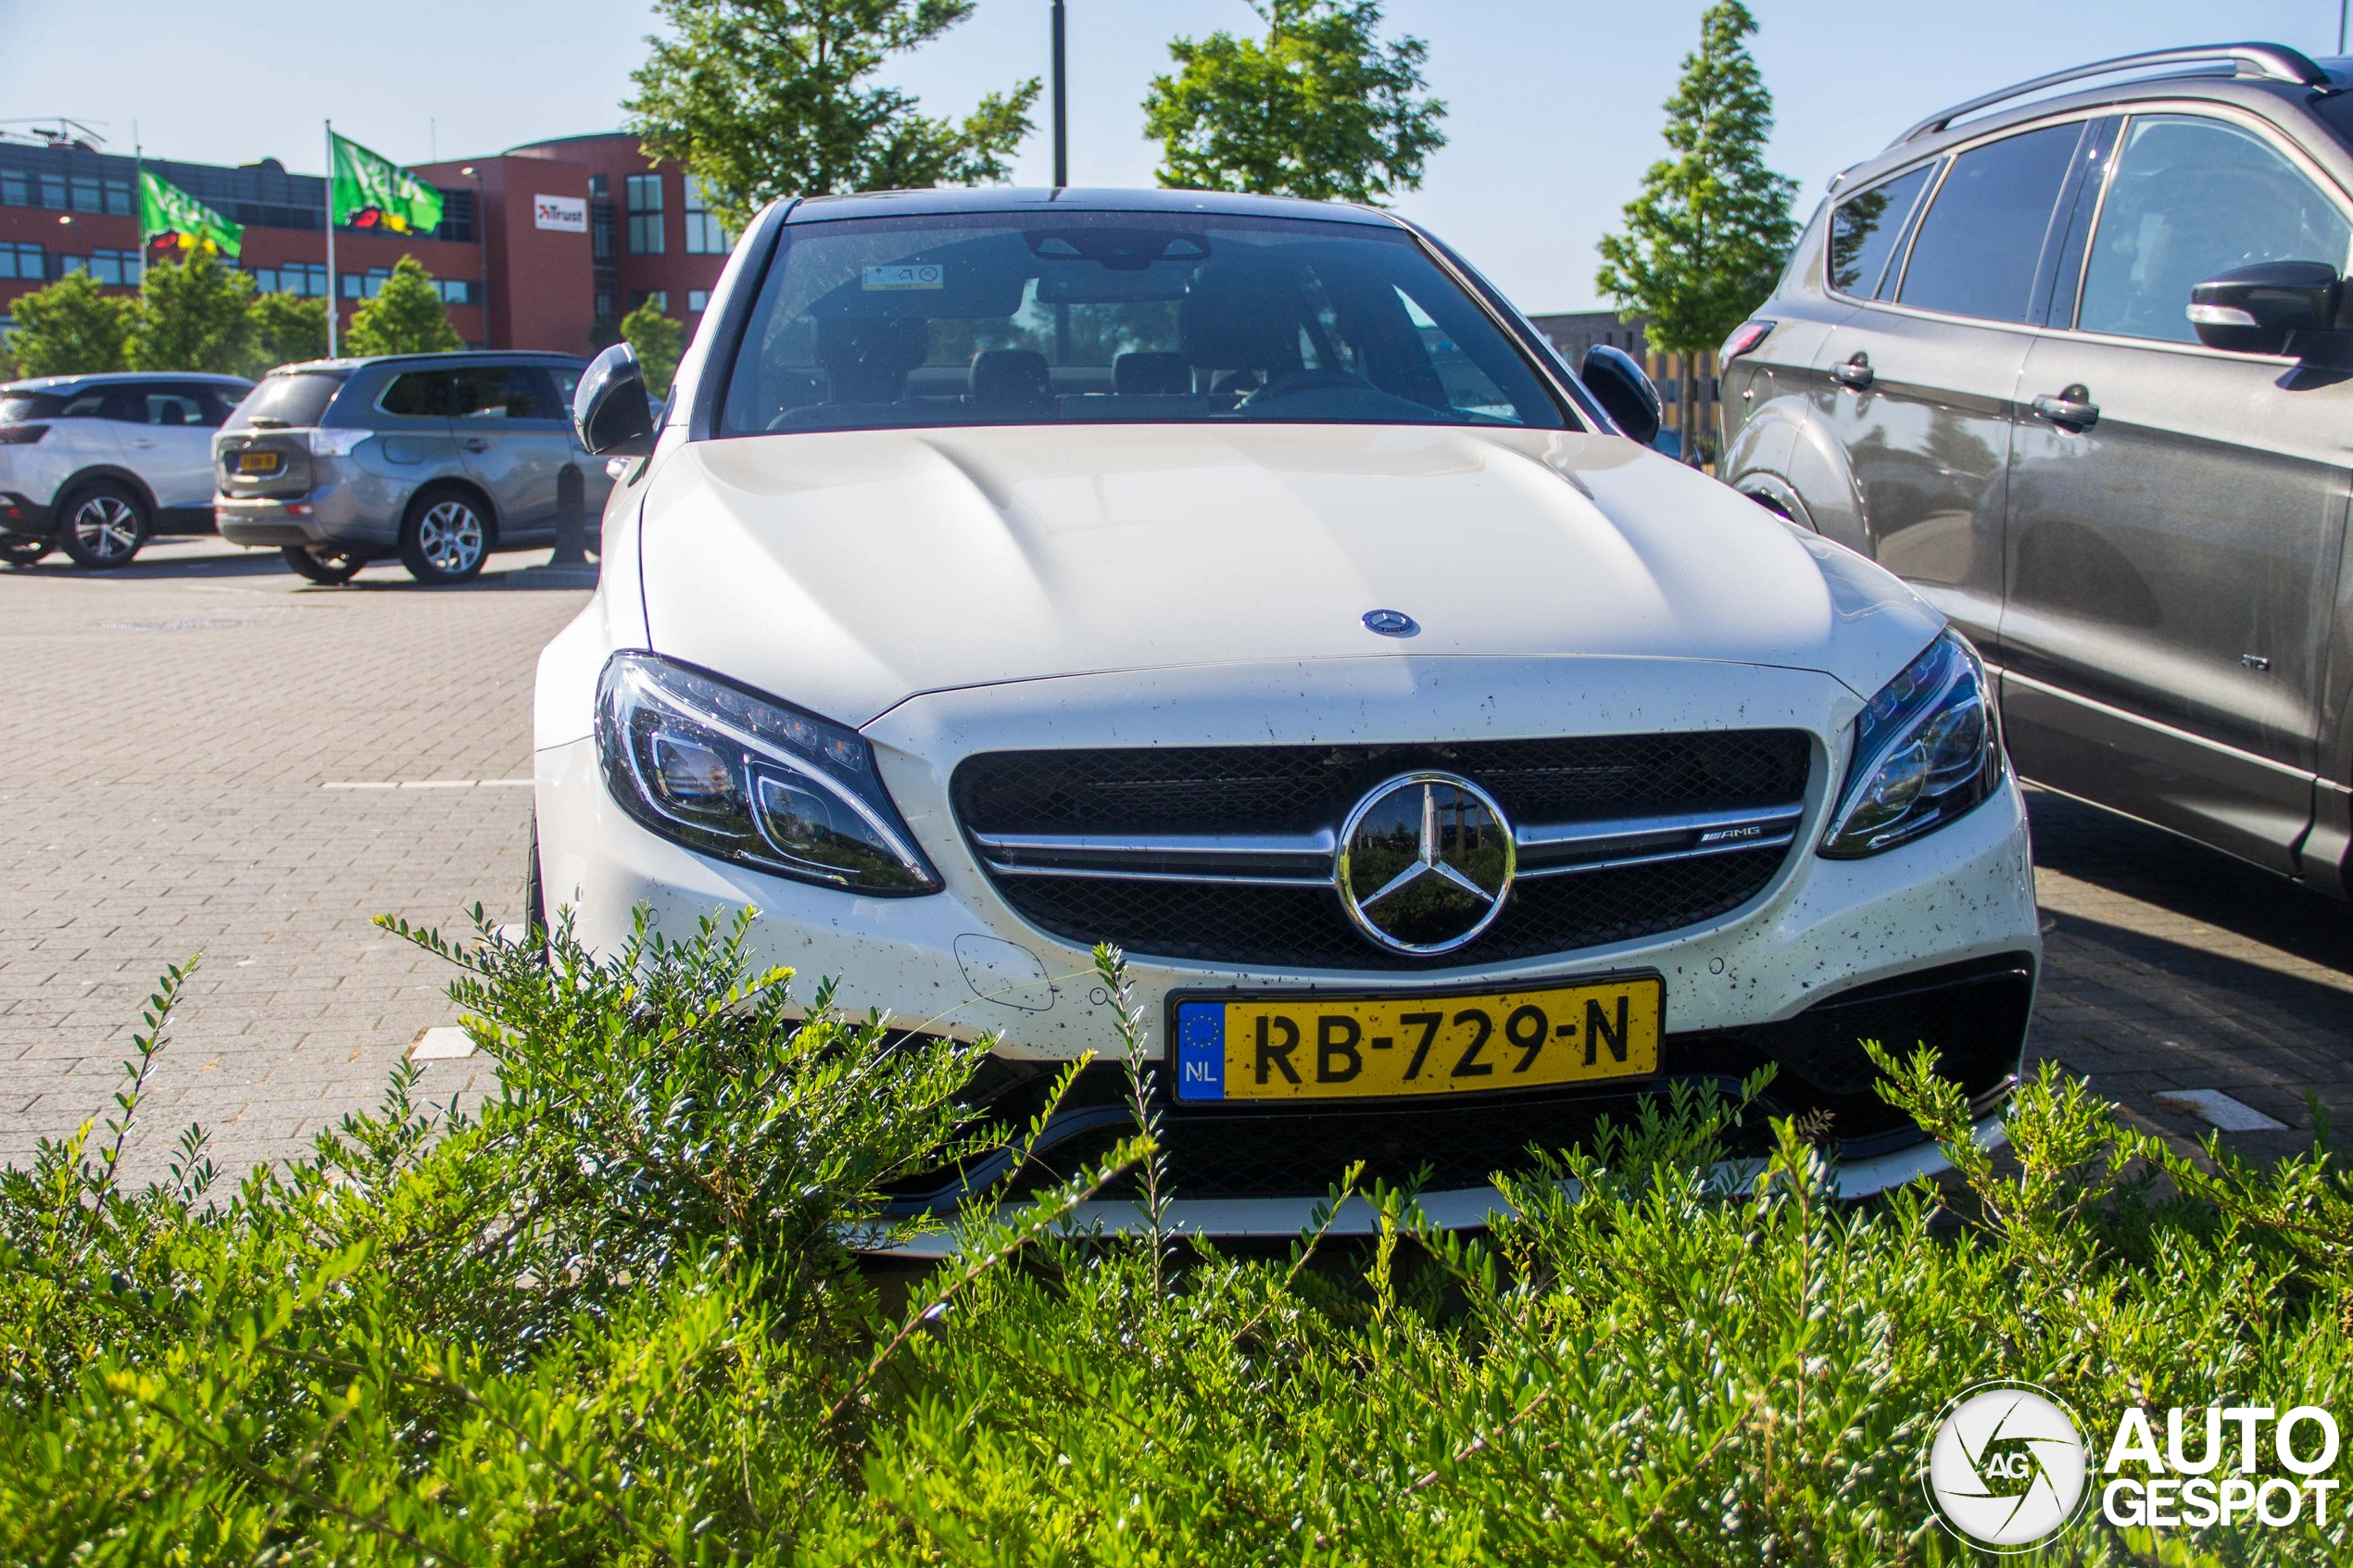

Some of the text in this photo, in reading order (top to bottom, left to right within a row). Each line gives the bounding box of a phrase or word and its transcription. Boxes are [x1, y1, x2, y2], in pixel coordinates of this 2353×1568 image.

[548, 205, 583, 223] Trust
[1720, 826, 1760, 839] AMG
[1254, 995, 1629, 1085] RB-729-N
[1185, 1061, 1217, 1082] NL
